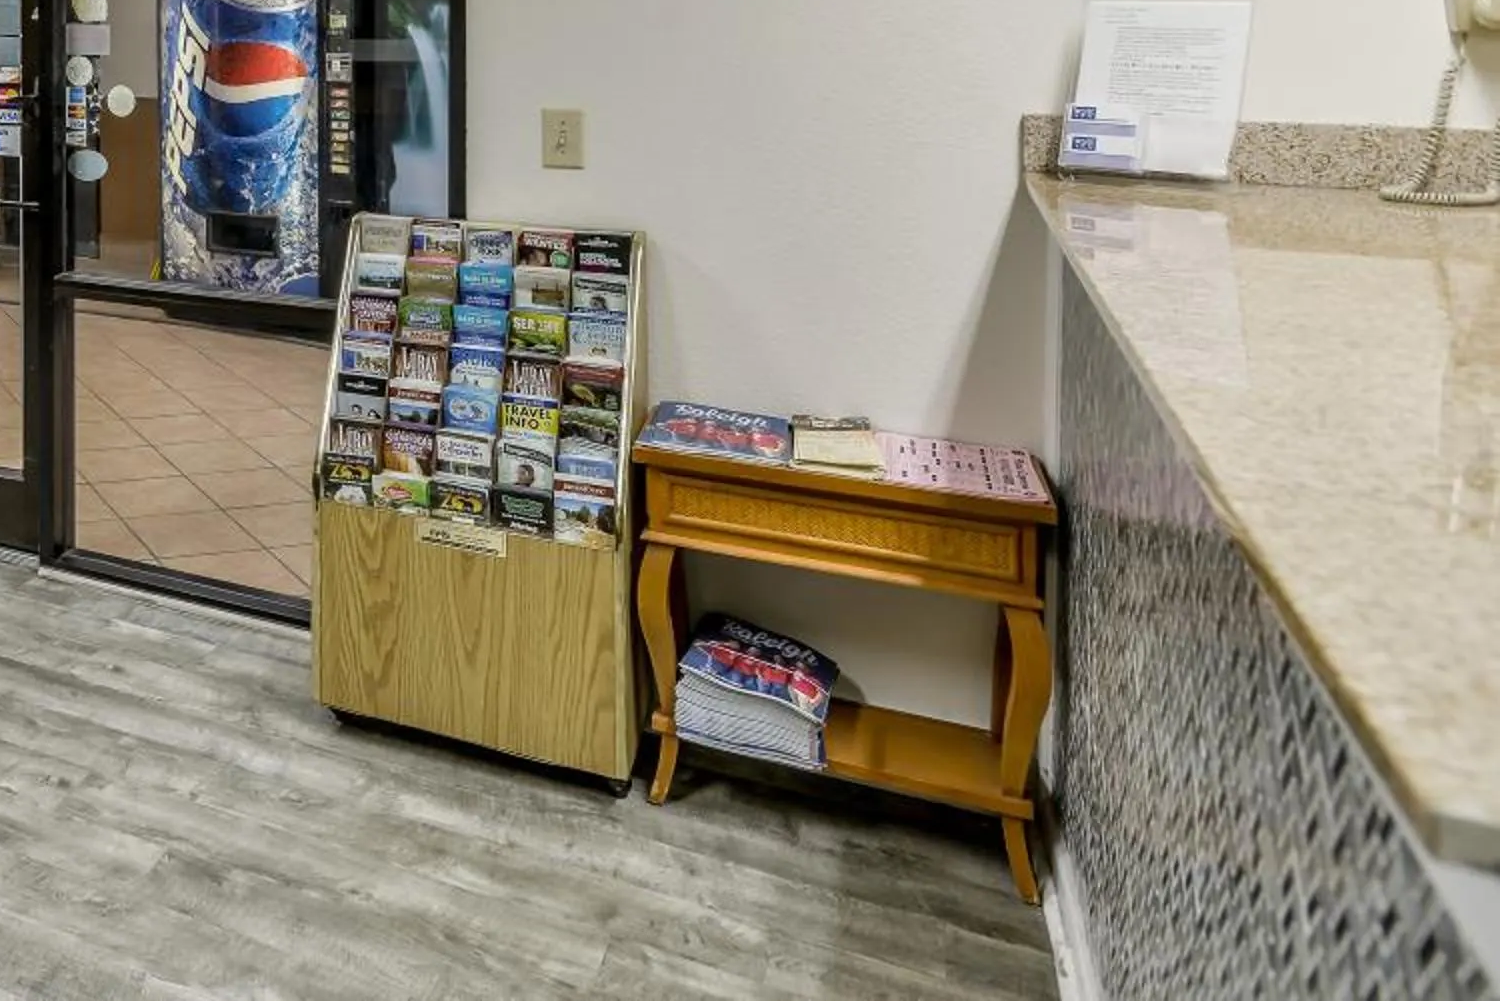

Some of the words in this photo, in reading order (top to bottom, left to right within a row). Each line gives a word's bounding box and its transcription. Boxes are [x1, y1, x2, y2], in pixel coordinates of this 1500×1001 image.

[165, 0, 210, 197] PEPSI
[503, 404, 552, 420] TRAVEL
[504, 416, 539, 430] INFO
[674, 403, 771, 428] Raleigh
[723, 618, 819, 666] Raleigh
